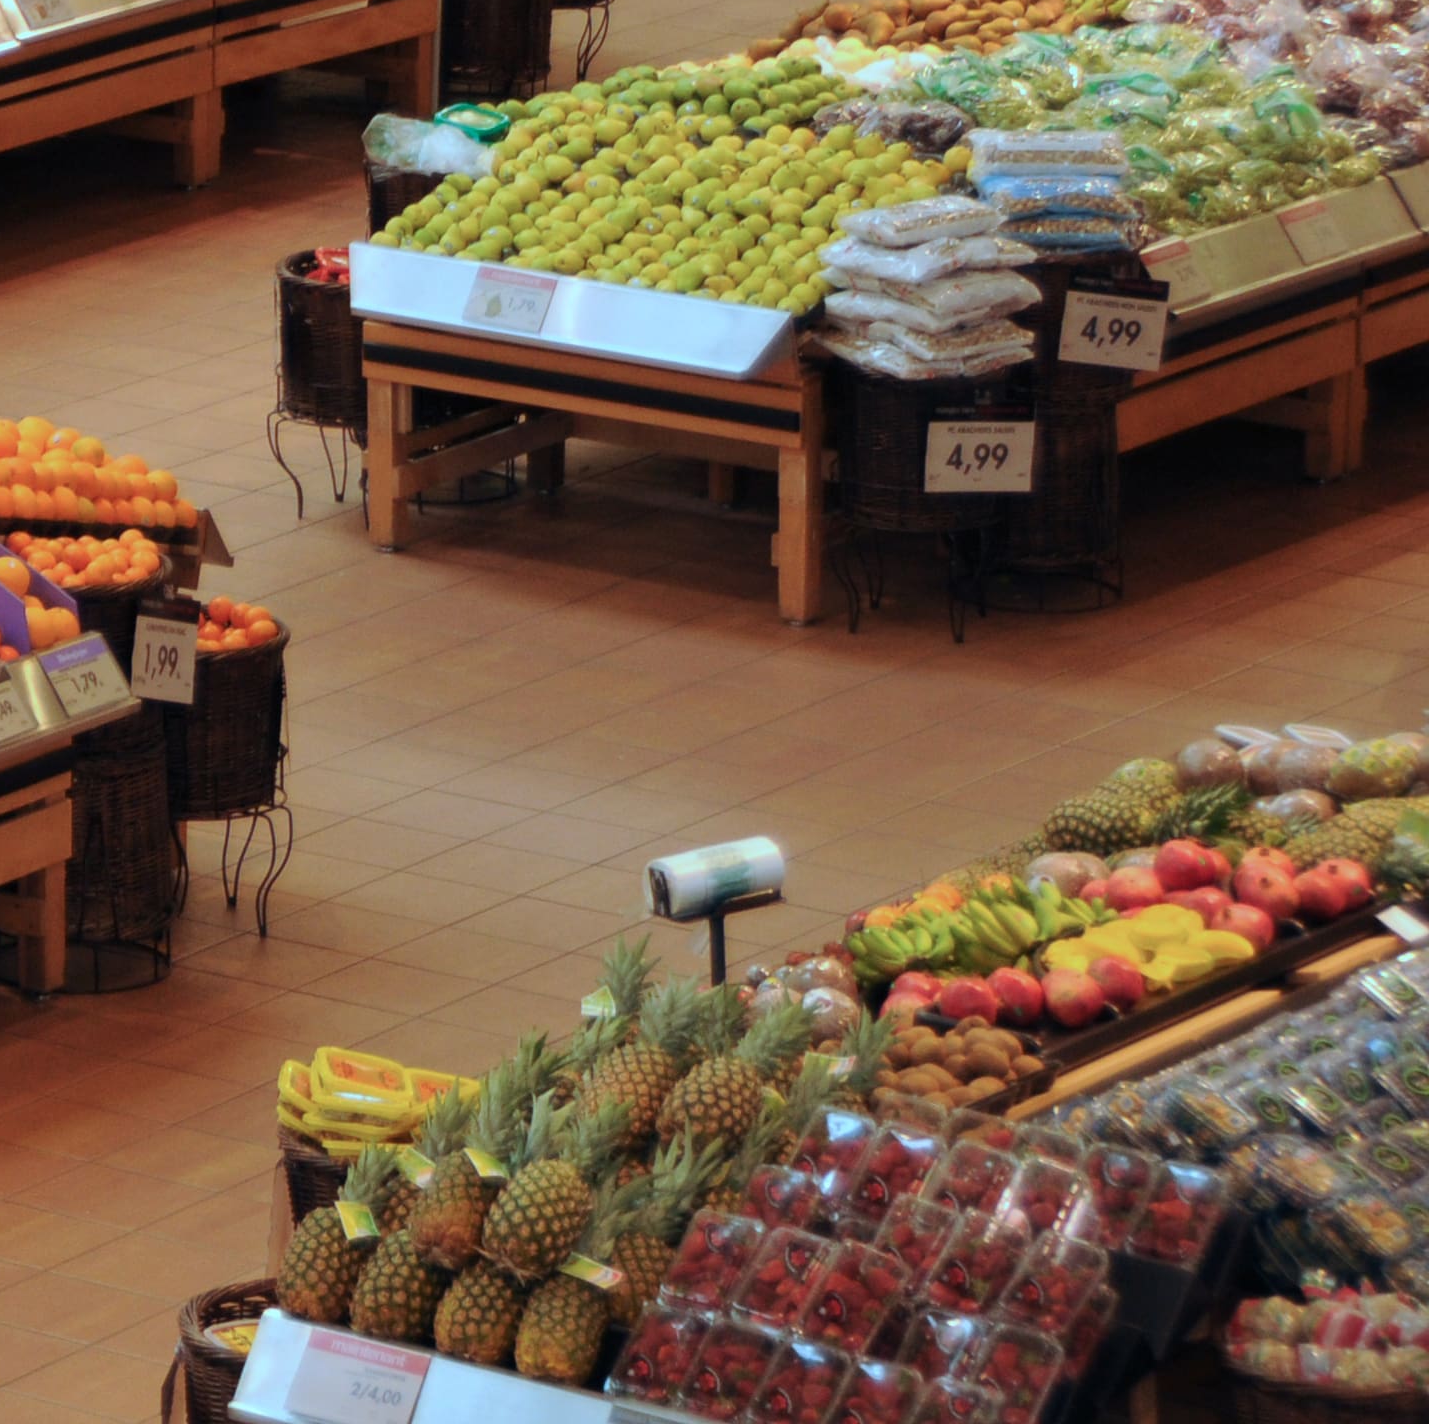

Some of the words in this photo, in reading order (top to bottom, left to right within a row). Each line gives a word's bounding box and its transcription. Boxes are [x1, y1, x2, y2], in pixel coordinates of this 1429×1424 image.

[508, 296, 535, 313] 1,79
[1080, 315, 1142, 349] 4,99
[946, 443, 1009, 475] 4,99
[145, 642, 179, 680] 1,99
[71, 671, 98, 694] 1,79
[330, 1339, 406, 1367] maintenant
[349, 1380, 401, 1406] 2/4,00
